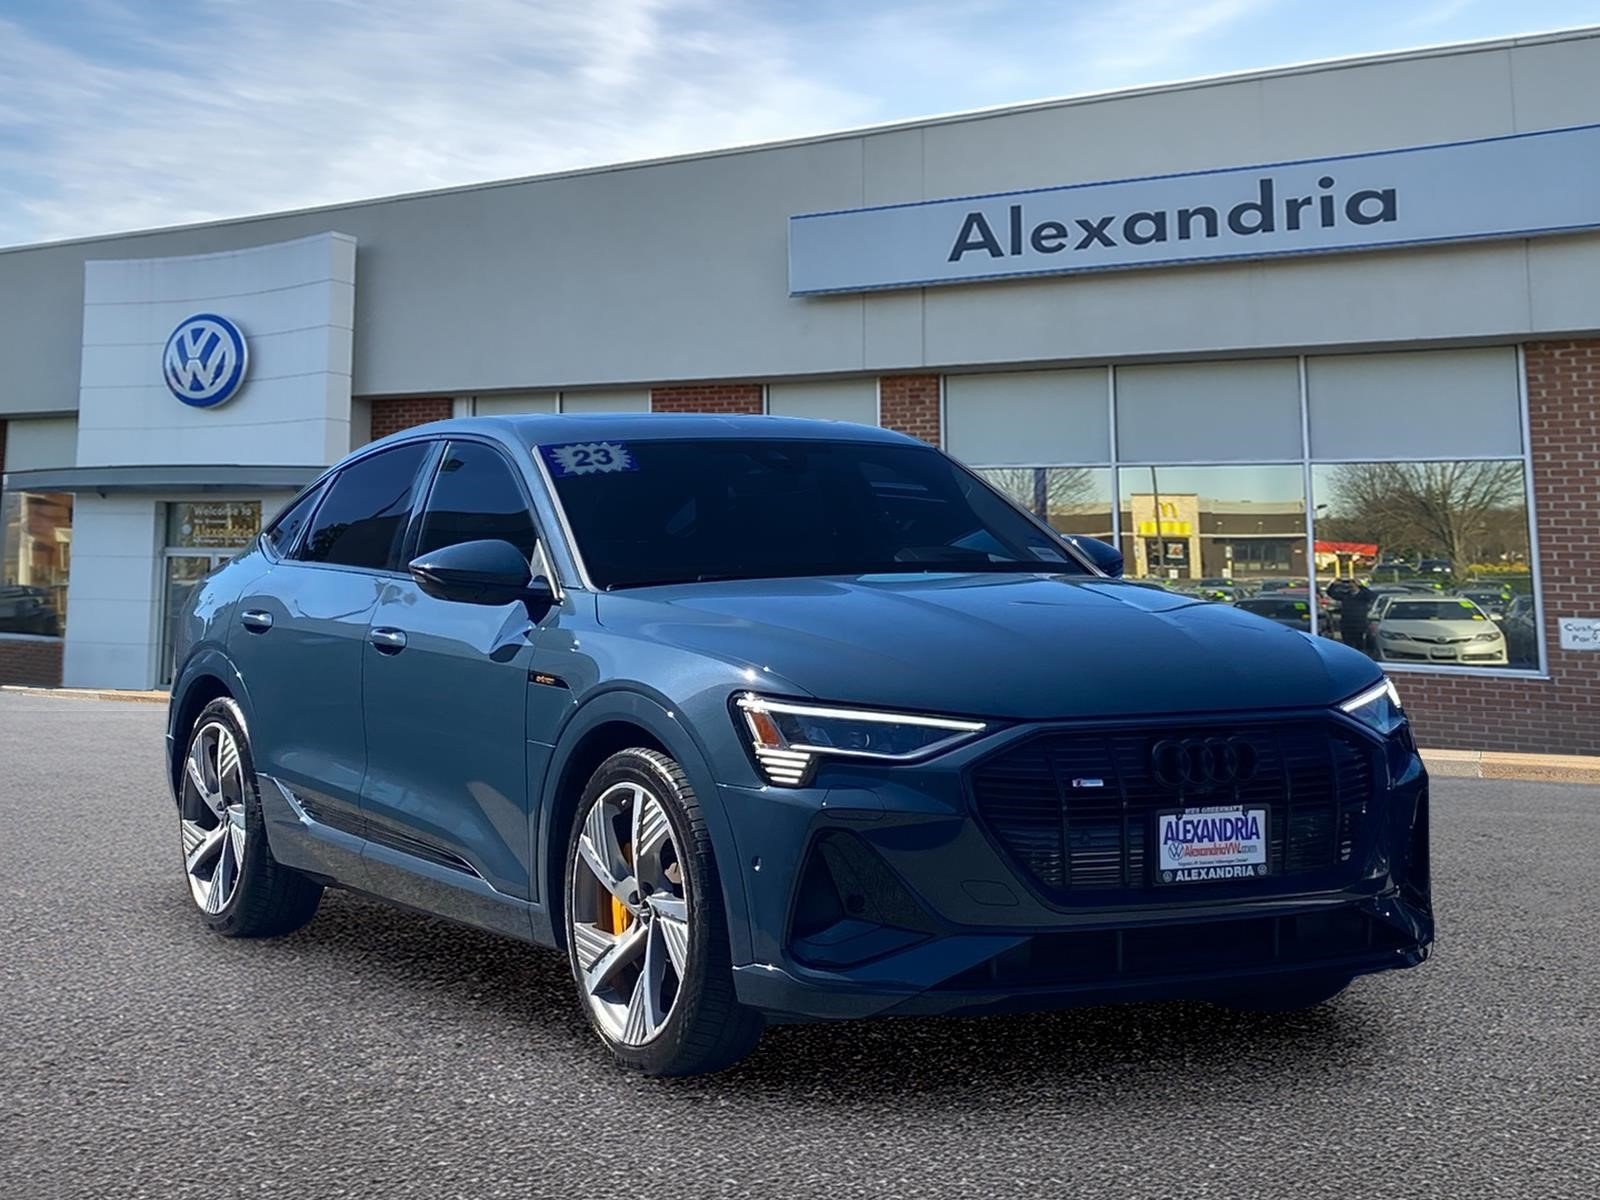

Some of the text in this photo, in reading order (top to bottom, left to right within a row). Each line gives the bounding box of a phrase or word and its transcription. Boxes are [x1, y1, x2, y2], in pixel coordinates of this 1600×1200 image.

[948, 176, 1398, 263] Alexandria
[572, 448, 614, 467] 23
[1164, 816, 1261, 845] ALEXANDRIA
[1175, 865, 1255, 881] ALEXANDRIA
